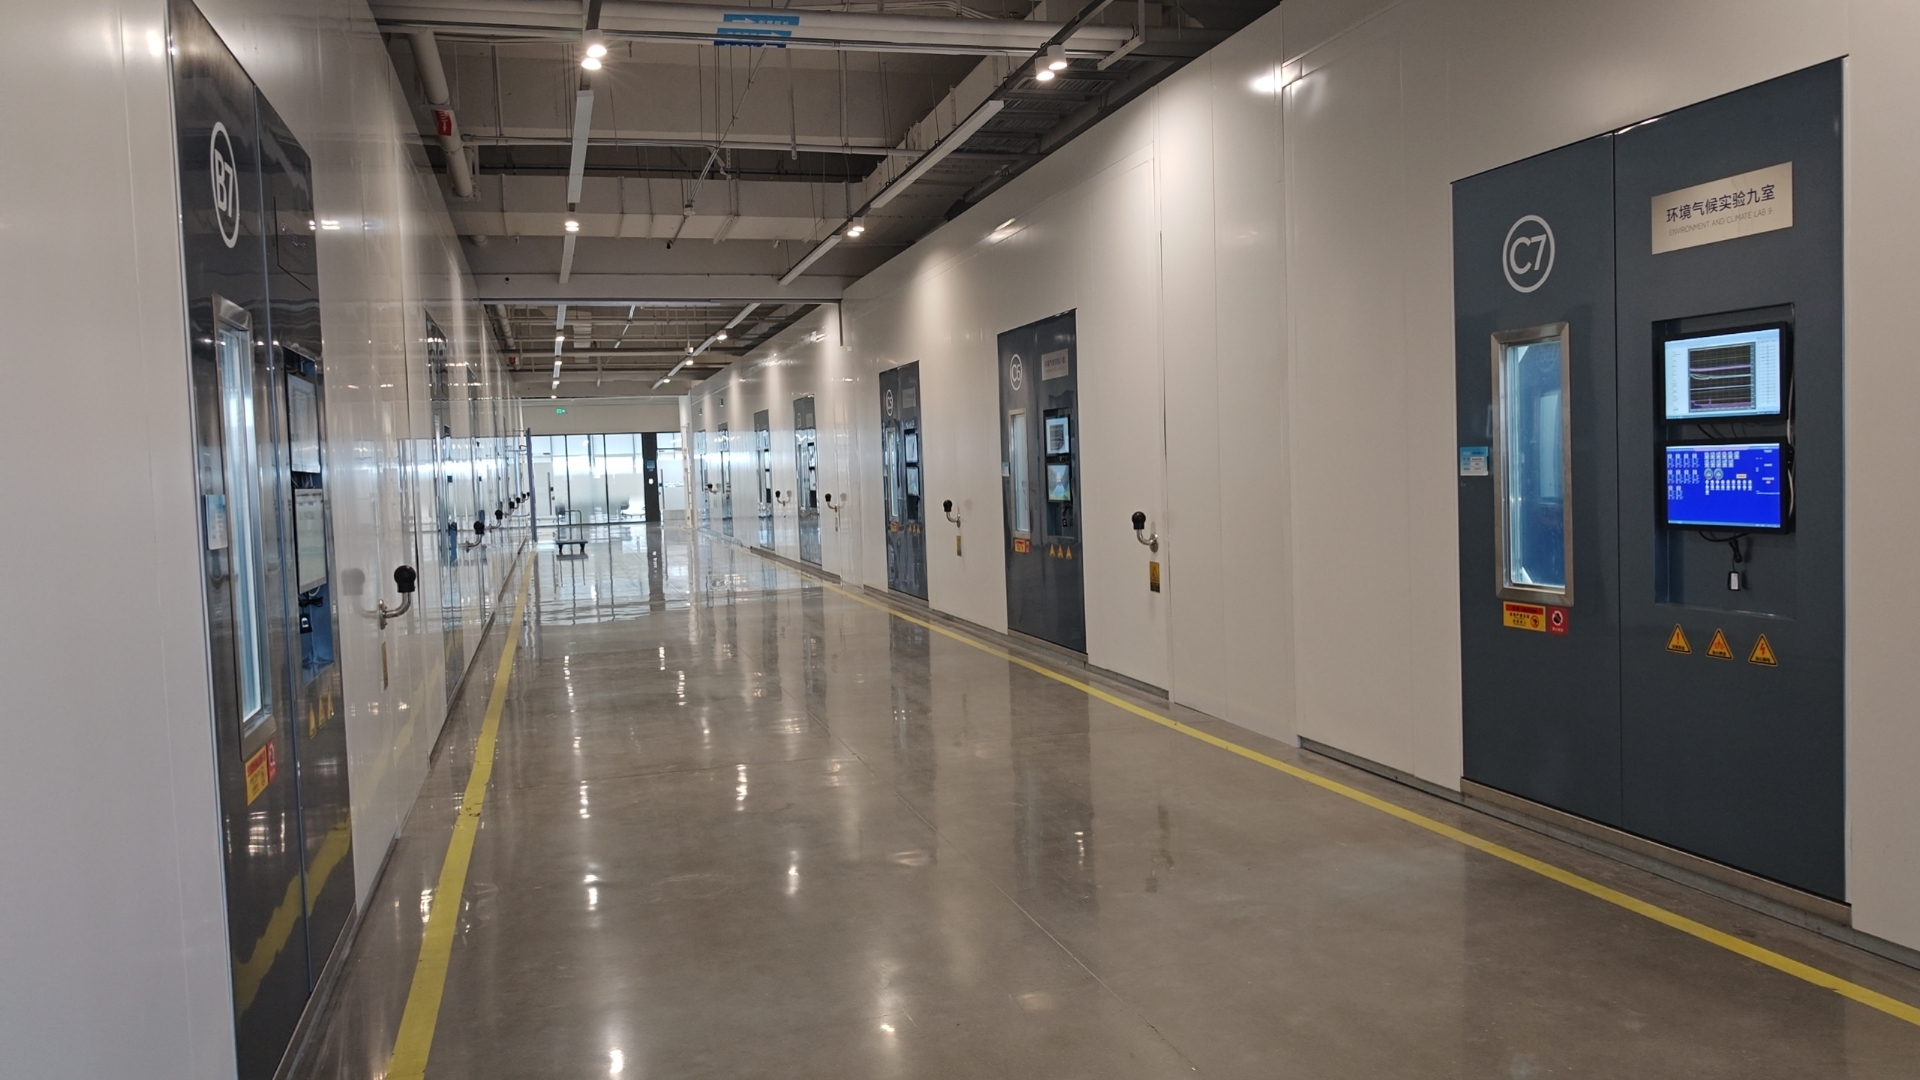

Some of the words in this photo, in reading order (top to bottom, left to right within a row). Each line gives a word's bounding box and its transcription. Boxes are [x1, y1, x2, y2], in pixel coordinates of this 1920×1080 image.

[214, 148, 233, 218] B7
[1666, 184, 1775, 222] 环境气候实验九室
[1668, 220, 1711, 236] ENVIRONMENT
[1711, 217, 1725, 227] AND
[1726, 211, 1752, 224] CLIMATE
[1753, 207, 1767, 218] LAB
[1509, 233, 1547, 275] C7
[1011, 363, 1022, 382] C6
